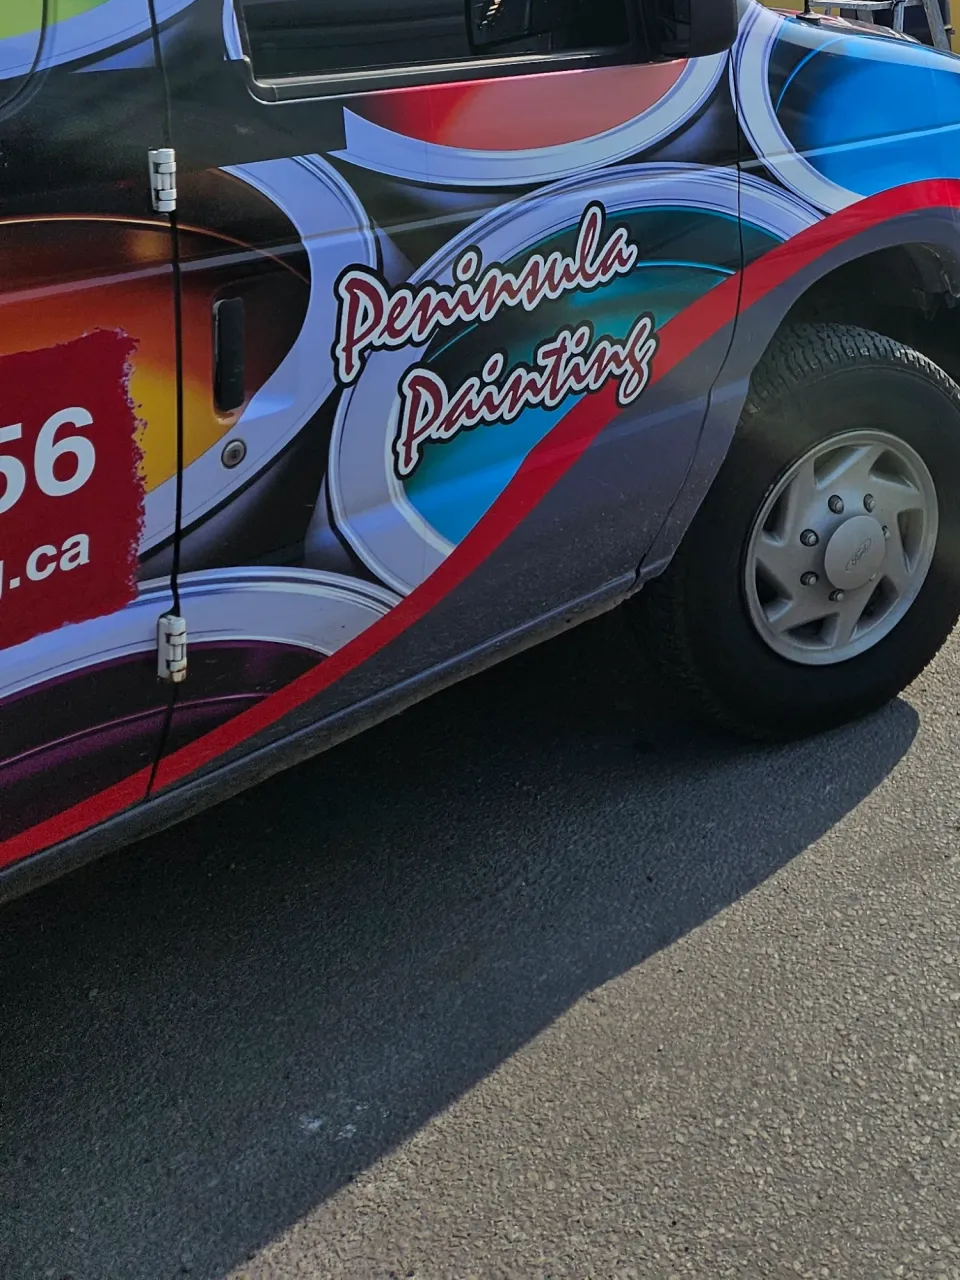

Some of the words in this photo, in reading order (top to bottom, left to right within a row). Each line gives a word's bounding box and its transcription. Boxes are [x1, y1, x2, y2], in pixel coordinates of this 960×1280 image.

[334, 203, 639, 383] Peninsula
[395, 314, 657, 476] Painting
[0, 533, 90, 600] .ca
